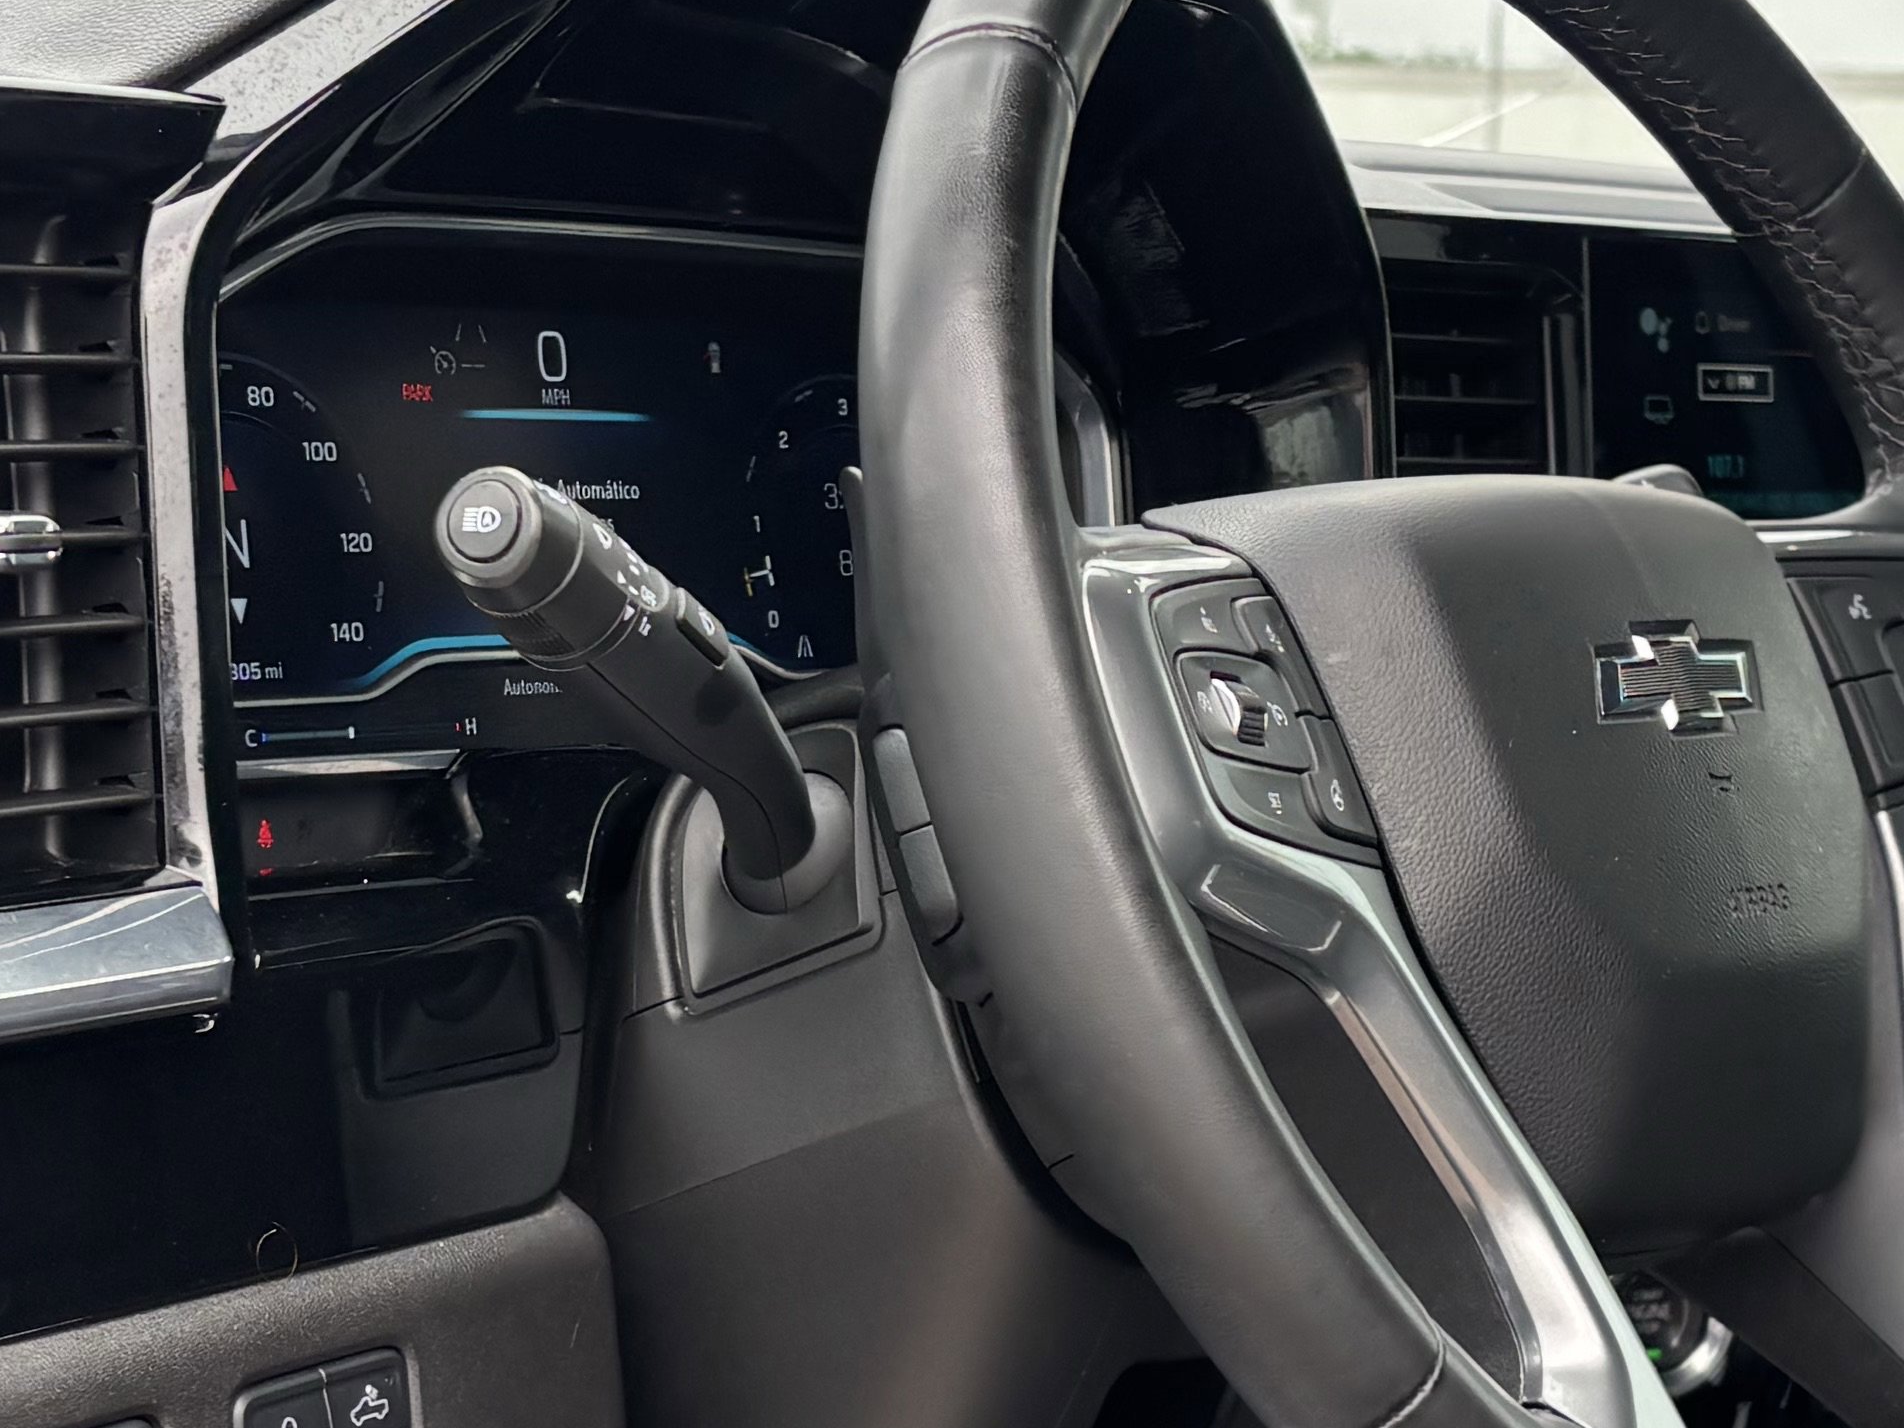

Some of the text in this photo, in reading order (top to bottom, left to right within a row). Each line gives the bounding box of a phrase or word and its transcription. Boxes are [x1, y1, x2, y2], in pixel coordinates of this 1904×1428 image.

[537, 330, 567, 382] 0
[246, 385, 275, 407] 80
[541, 388, 571, 406] MPH
[837, 398, 848, 415] 3
[778, 430, 789, 449] 2
[301, 441, 337, 462] 100
[753, 515, 761, 533] 1
[339, 532, 373, 553] 120
[767, 610, 780, 629] 0
[330, 622, 365, 643] 140
[265, 661, 283, 679] mi
[465, 717, 477, 736] H
[245, 729, 258, 747] C
